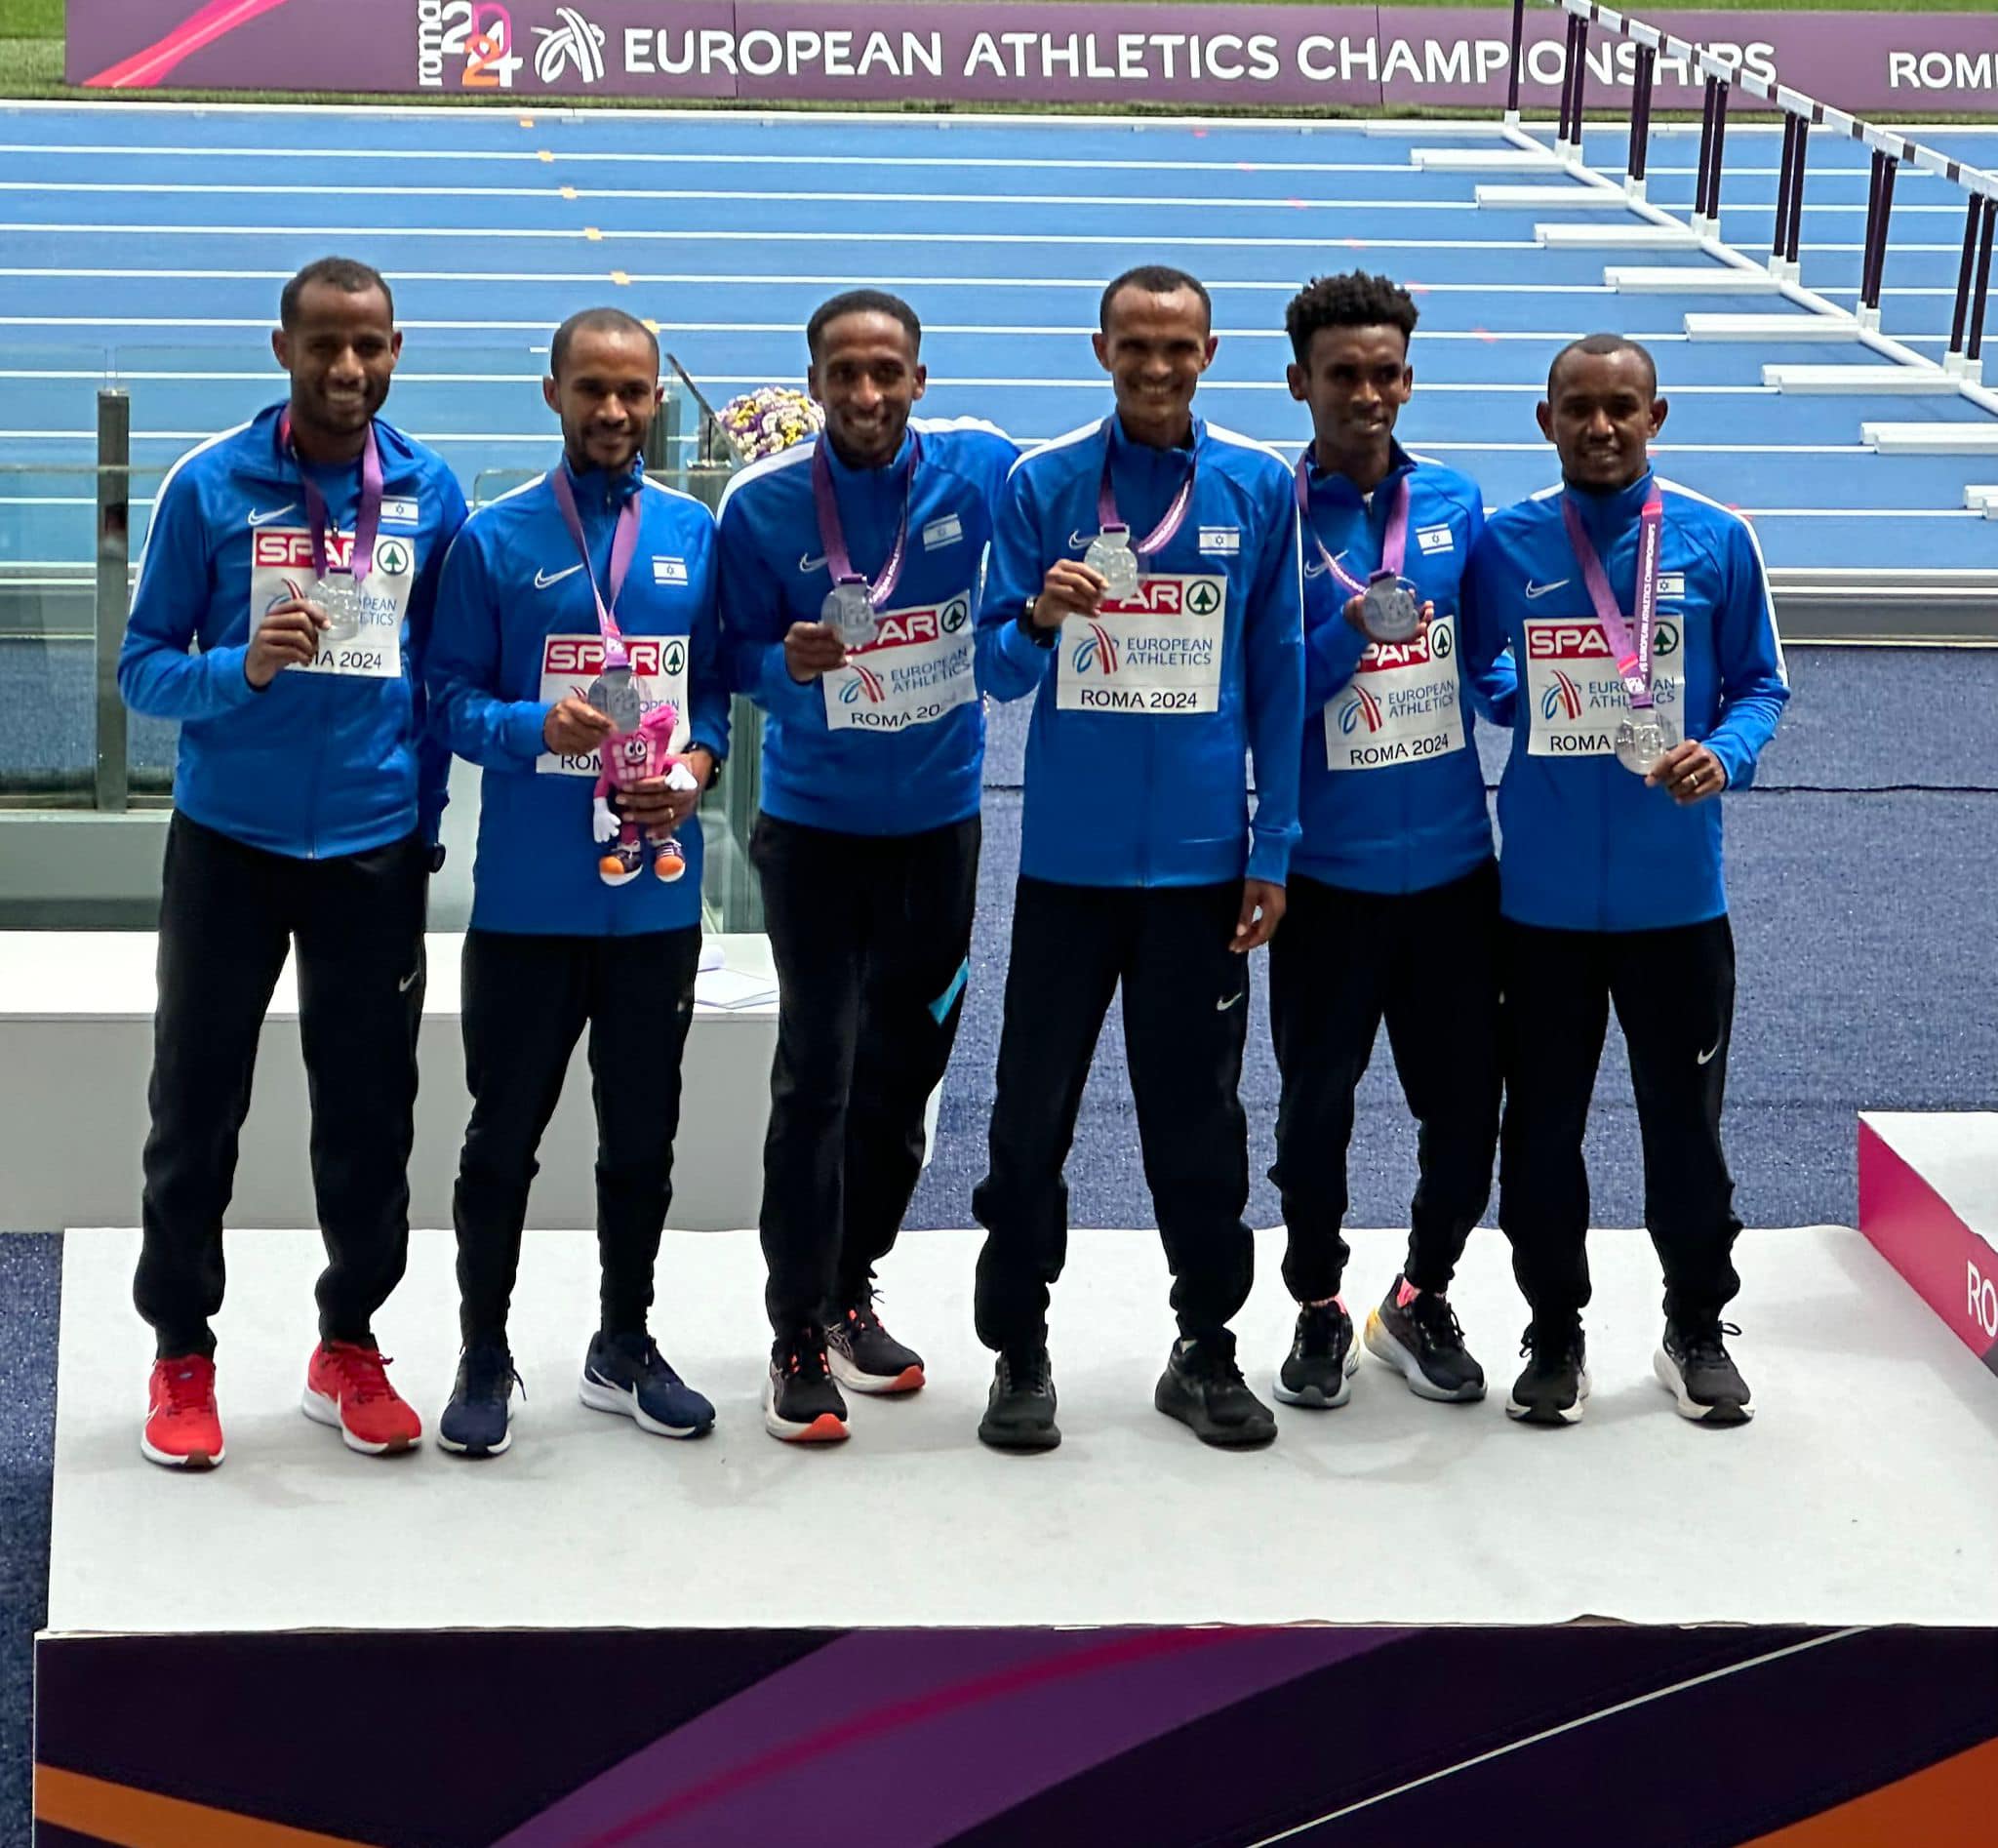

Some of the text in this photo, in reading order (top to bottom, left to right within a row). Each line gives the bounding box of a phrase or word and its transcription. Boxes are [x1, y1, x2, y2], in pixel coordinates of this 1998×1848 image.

[624, 28, 942, 76] EUROPEAN
[964, 32, 1279, 79] ATHLETICS
[1119, 584, 1179, 610] AR
[878, 616, 937, 645] AR
[1531, 628, 1609, 655] SPA
[548, 644, 658, 671] SPR
[1127, 638, 1213, 653] EUROPEAN
[1360, 635, 1428, 667] PAR
[340, 651, 382, 669] 2024
[891, 647, 968, 682] EUROPEAN
[1126, 652, 1212, 665] ATHLETICS
[893, 662, 971, 694] ATHLETICS
[1081, 689, 1198, 708] ROMA 2024
[1388, 679, 1455, 703] EUROPEAN
[1589, 692, 1676, 708] ATHLICS
[1388, 694, 1455, 719] ATHLETICS
[851, 711, 911, 728] ROMA
[1350, 733, 1450, 766] ROMA 2024
[1550, 735, 1612, 751] ROMA
[561, 754, 604, 771] ROM
